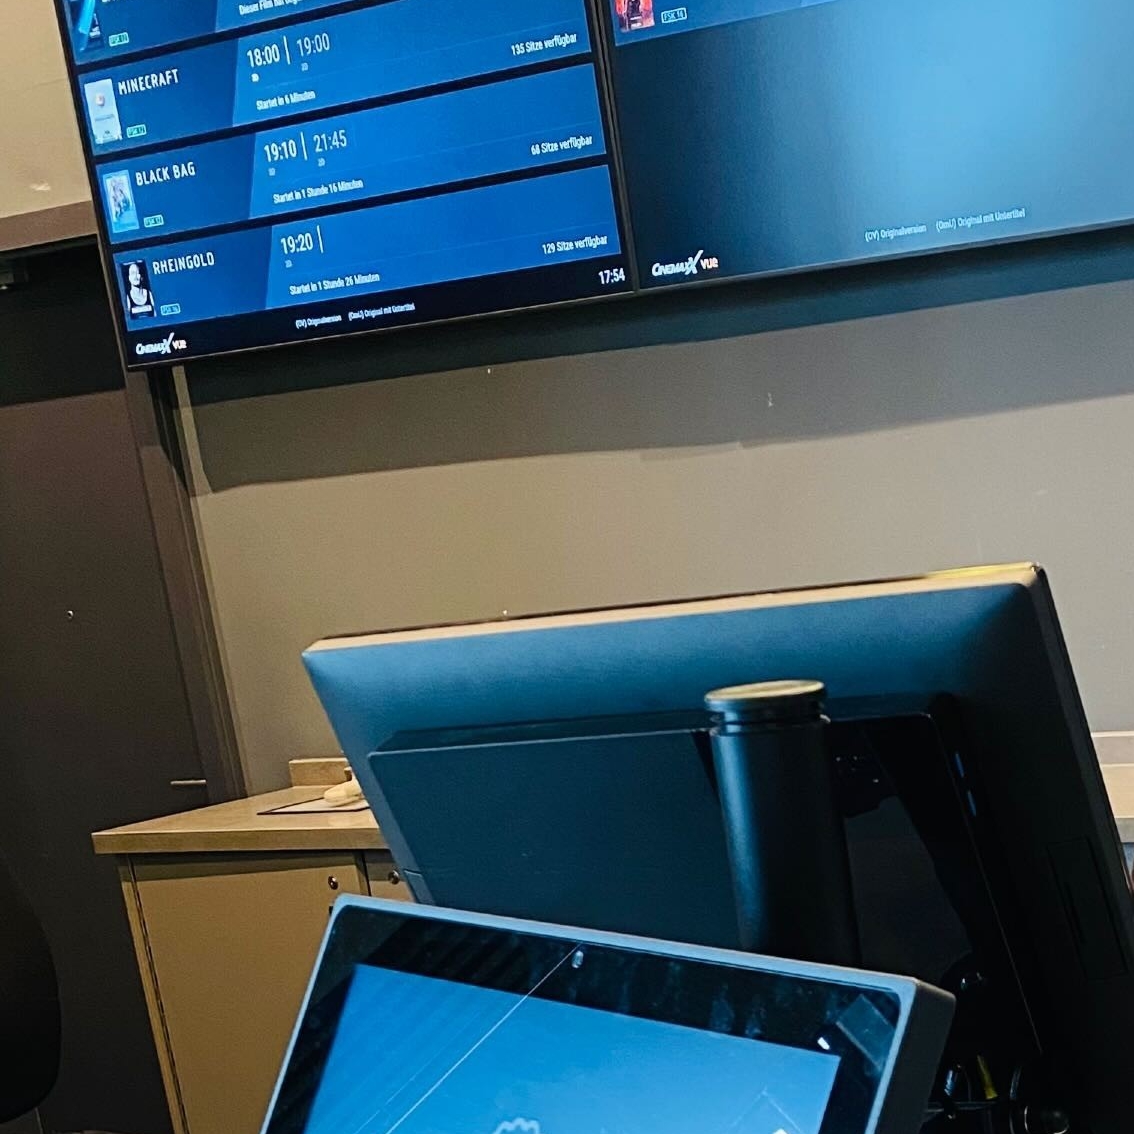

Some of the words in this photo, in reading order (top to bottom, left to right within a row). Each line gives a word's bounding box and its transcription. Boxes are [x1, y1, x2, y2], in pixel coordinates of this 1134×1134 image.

[247, 44, 280, 68] 18:00
[297, 33, 330, 57] 19:00
[511, 43, 525, 56] 135
[525, 39, 543, 53] Sitze
[118, 69, 179, 95] MINECRAFT
[264, 139, 297, 162] 19:10
[313, 129, 347, 153] 21:45
[541, 141, 558, 153] Sitze
[135, 167, 170, 186] BLACK
[172, 161, 196, 179] BAG
[301, 188, 307, 198] 1
[328, 182, 338, 193] 16
[280, 232, 314, 254] 19:20
[542, 243, 556, 255] 129
[556, 240, 574, 252] Sitze
[152, 251, 215, 275] RHEINGOLD
[317, 280, 322, 290] 1
[322, 277, 344, 290] Stunde
[345, 275, 354, 286] 26
[598, 267, 626, 285] 17:54
